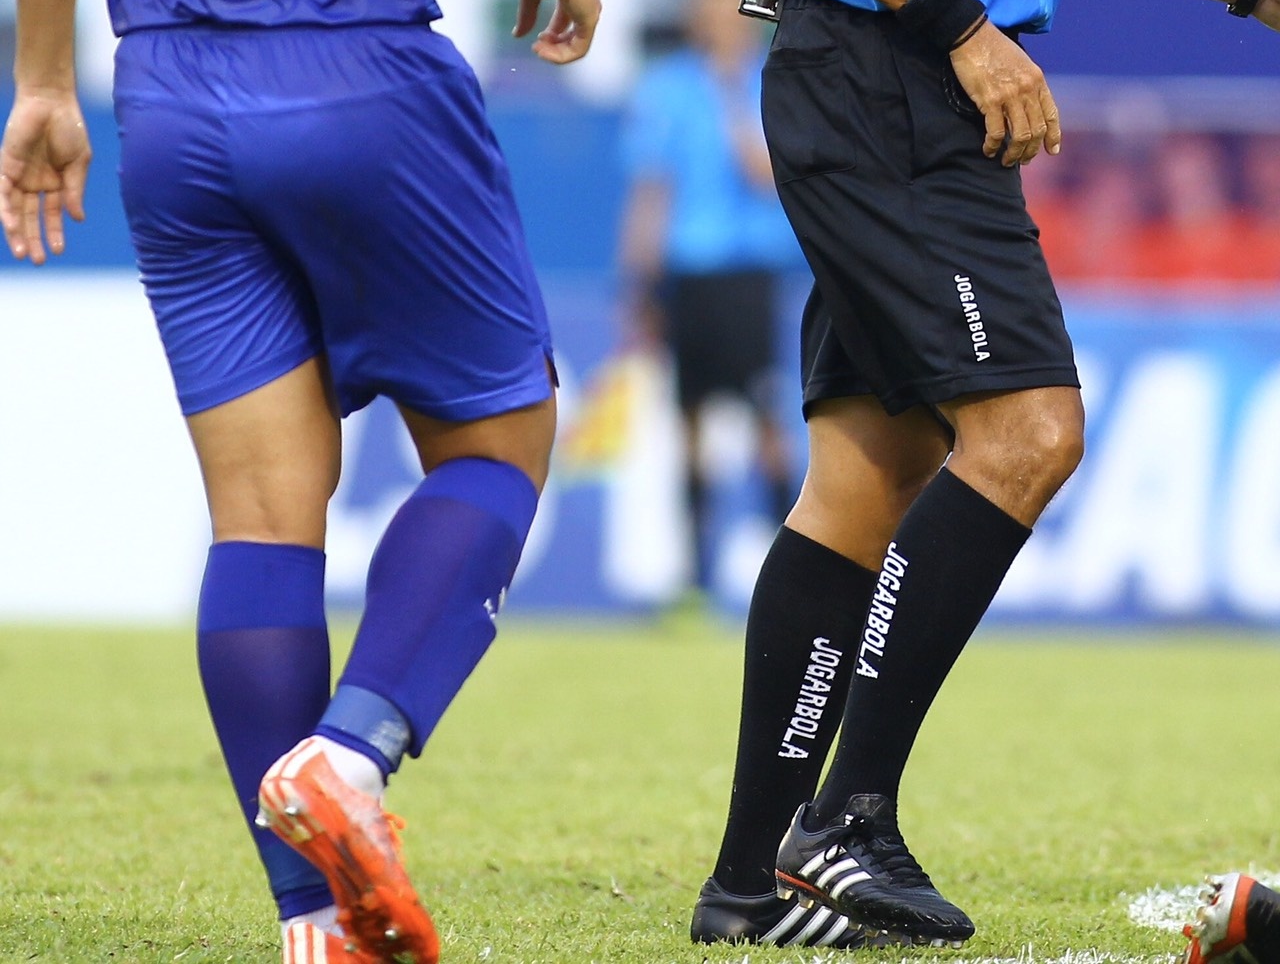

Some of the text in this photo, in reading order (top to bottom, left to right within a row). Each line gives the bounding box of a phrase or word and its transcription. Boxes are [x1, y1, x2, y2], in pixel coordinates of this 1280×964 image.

[953, 274, 991, 363] JOGARBOLA
[855, 541, 910, 679] JOGARBOLA
[777, 636, 843, 760] JOGARBOLA
